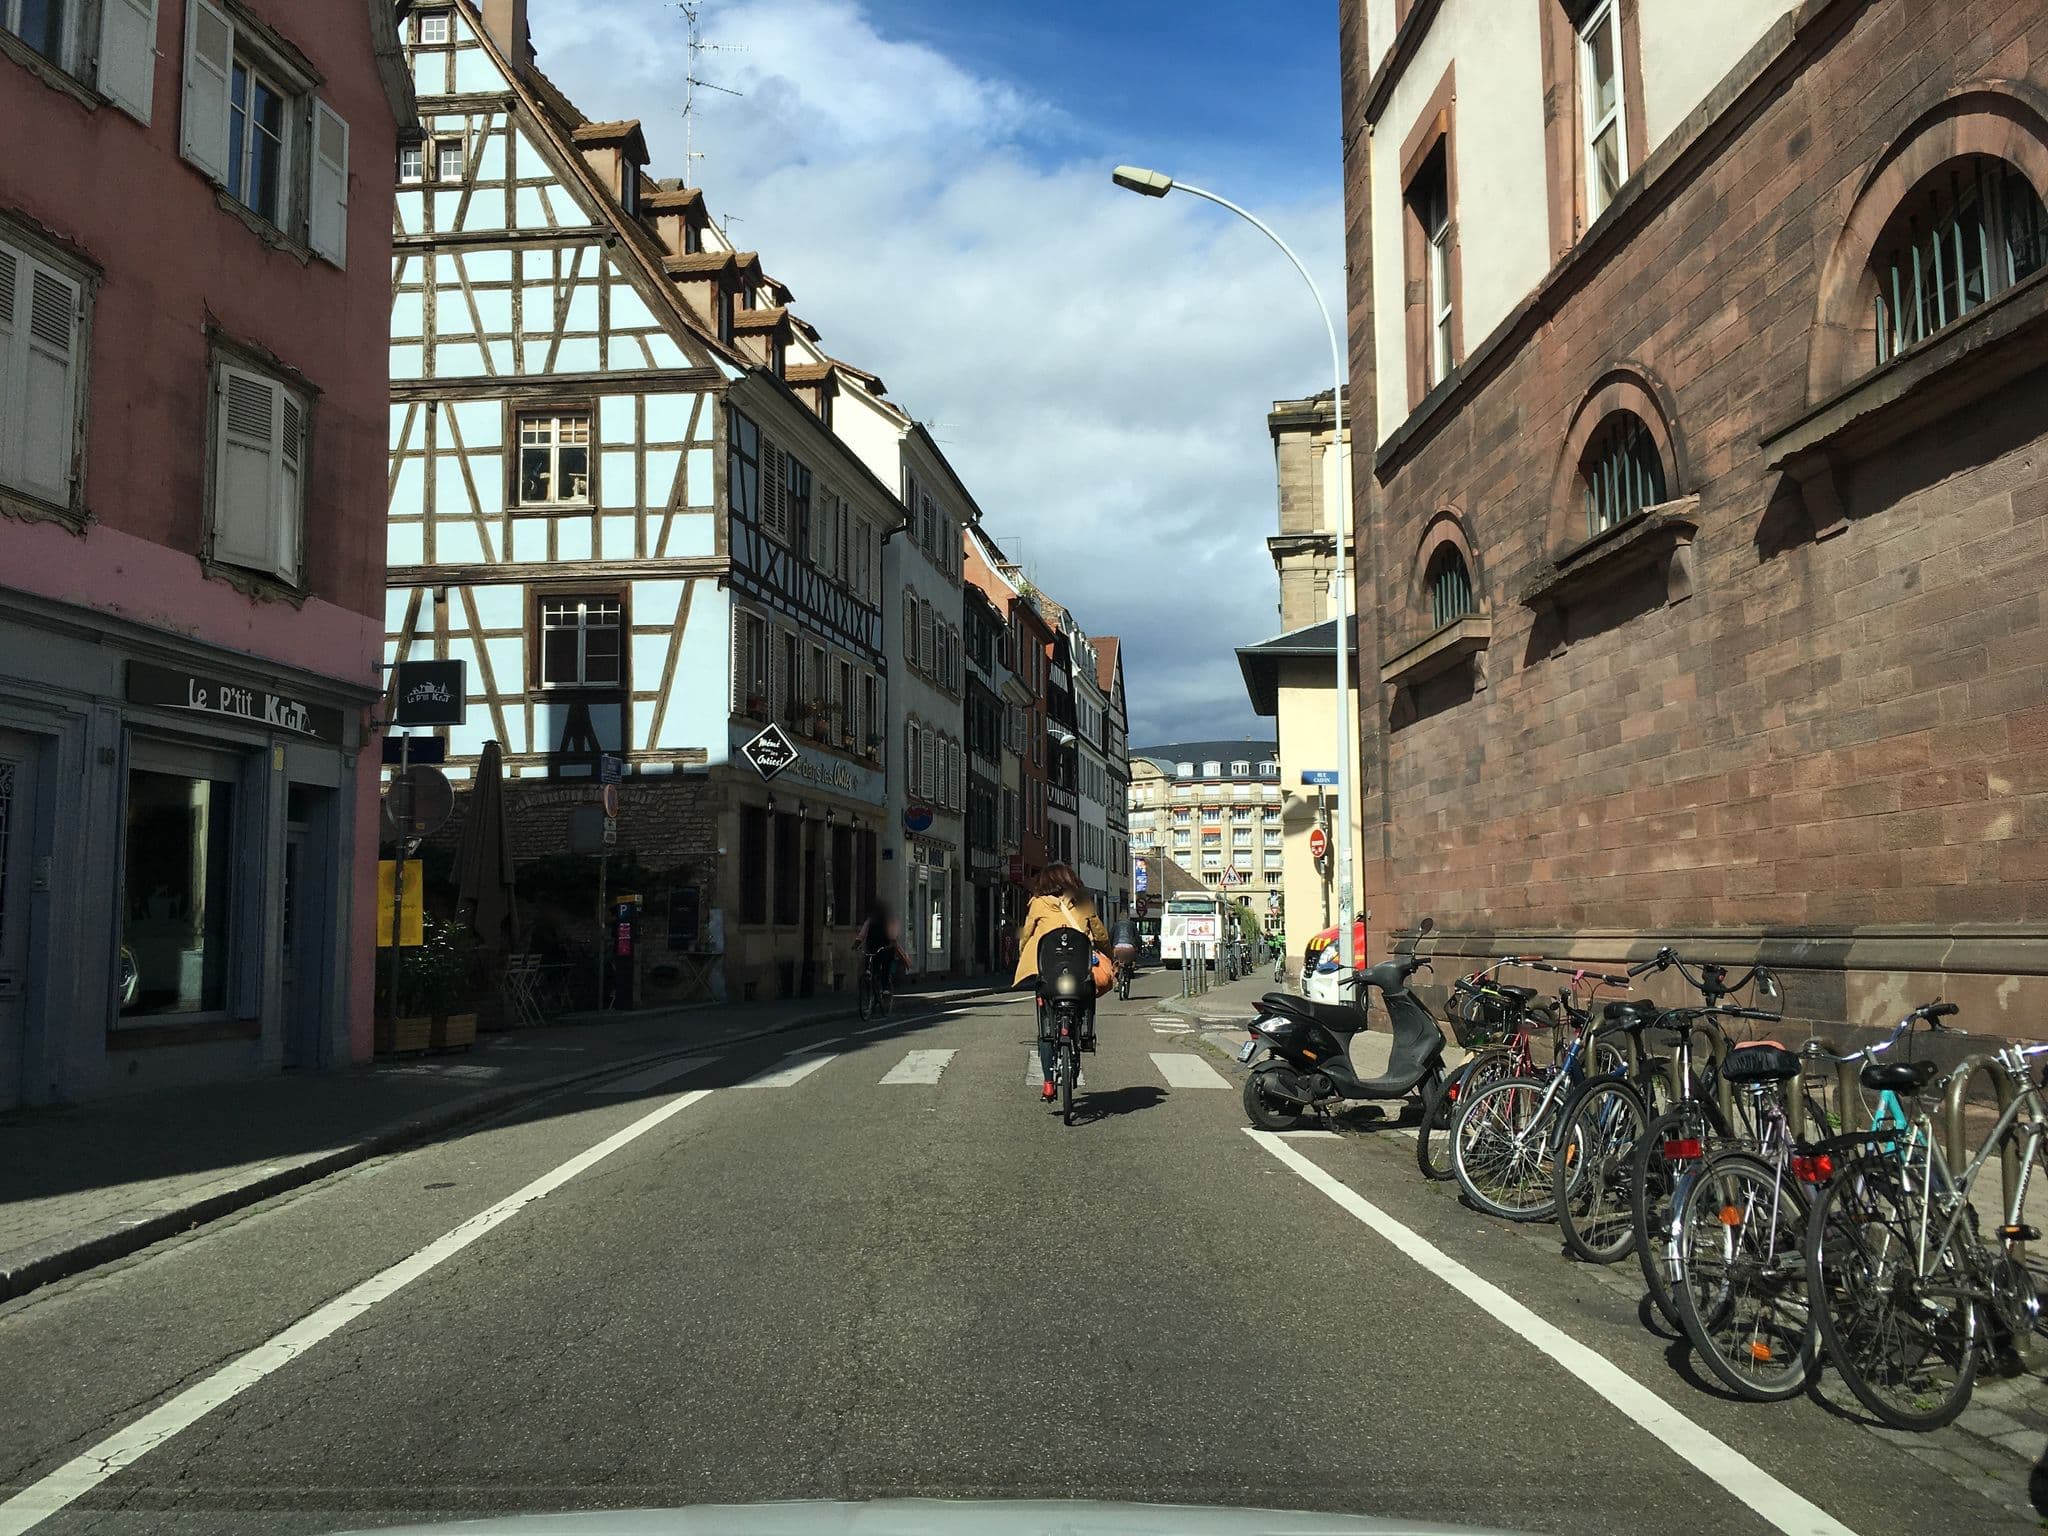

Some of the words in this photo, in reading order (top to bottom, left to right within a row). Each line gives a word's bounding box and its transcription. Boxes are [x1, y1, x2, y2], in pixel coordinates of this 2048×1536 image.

[189, 678, 208, 709] Le
[407, 696, 415, 704] Le
[620, 904, 628, 916] P
